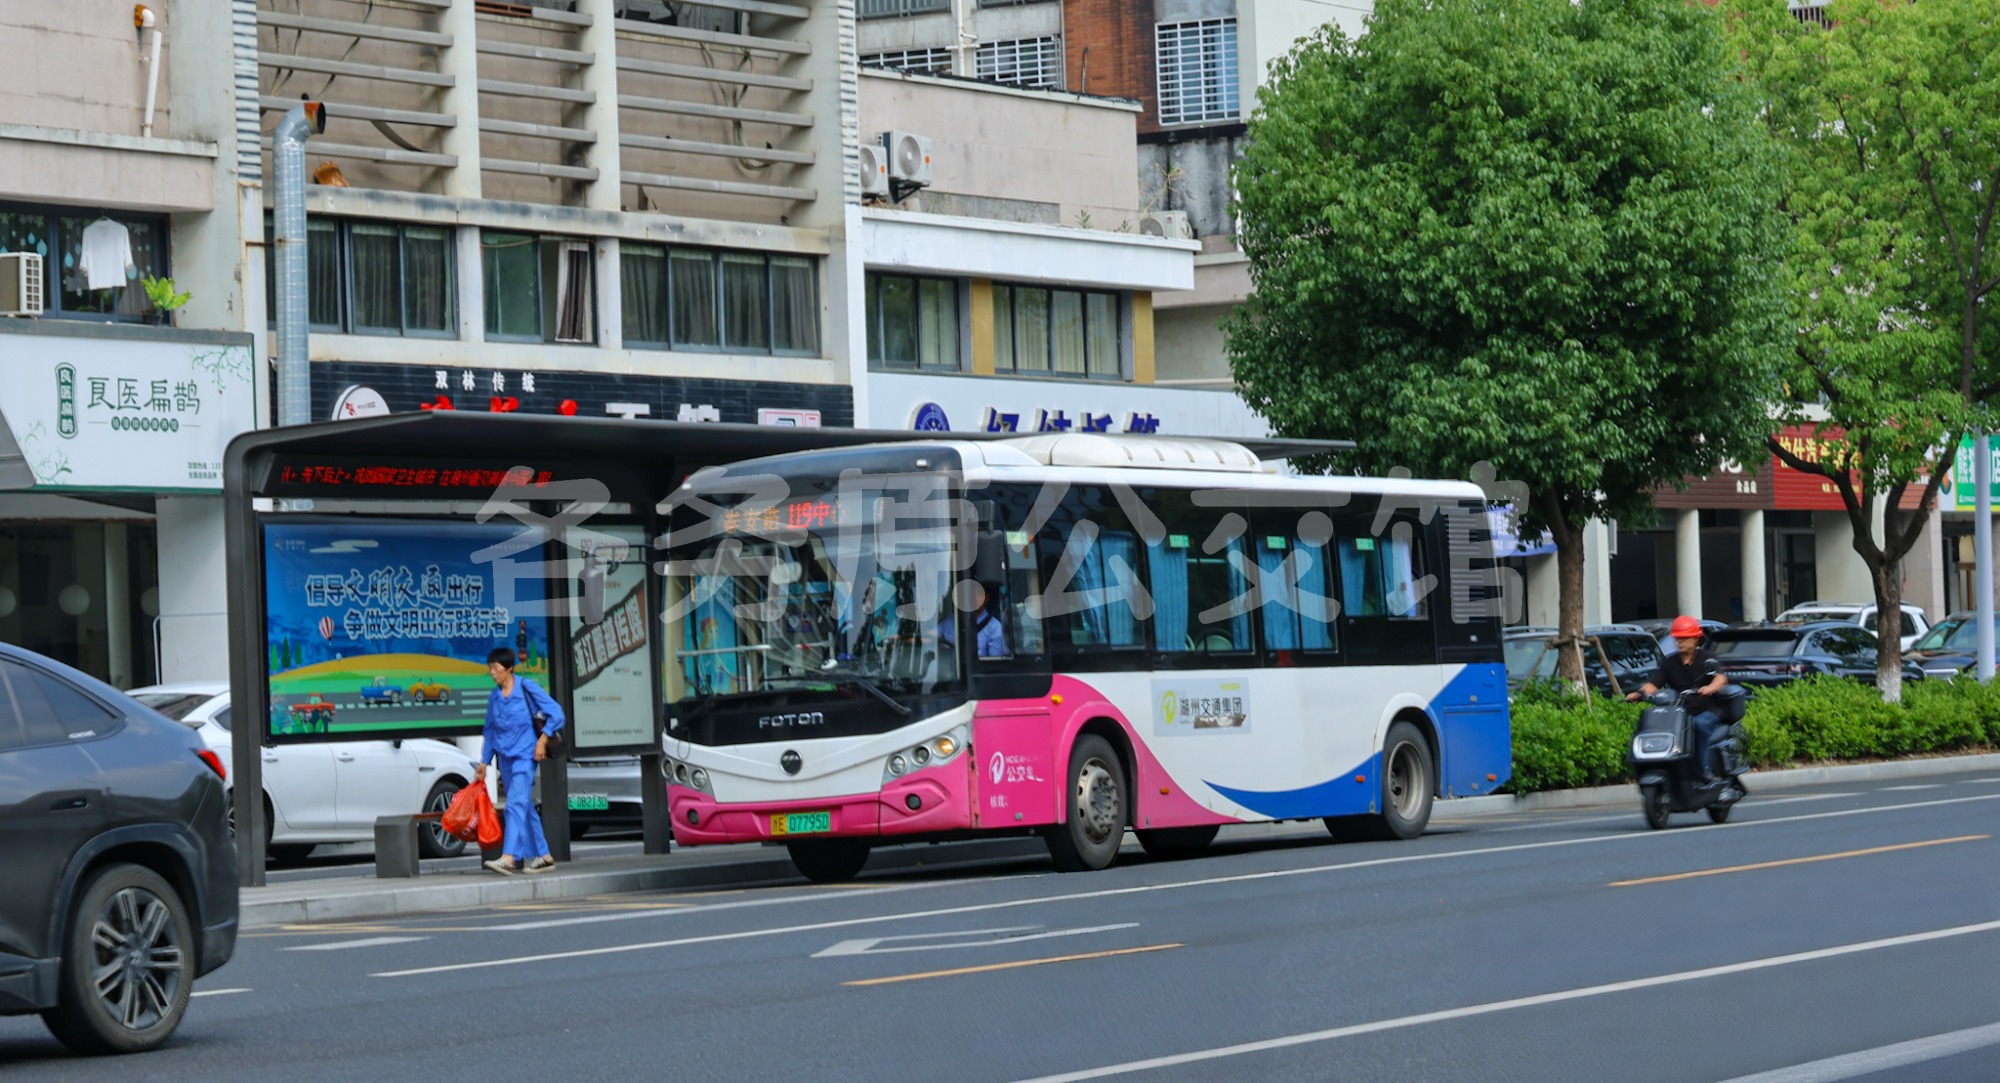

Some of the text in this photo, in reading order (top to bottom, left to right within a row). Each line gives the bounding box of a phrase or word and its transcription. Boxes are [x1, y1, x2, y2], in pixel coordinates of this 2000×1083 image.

[86, 376, 201, 415] 良医扁鹊
[434, 369, 536, 394] 双林传统
[305, 564, 484, 608] 倡导文明交通出行
[343, 606, 509, 640] 争做文明出行践行者
[758, 711, 824, 728] FOTON
[1179, 697, 1243, 718] 湖州交通集团
